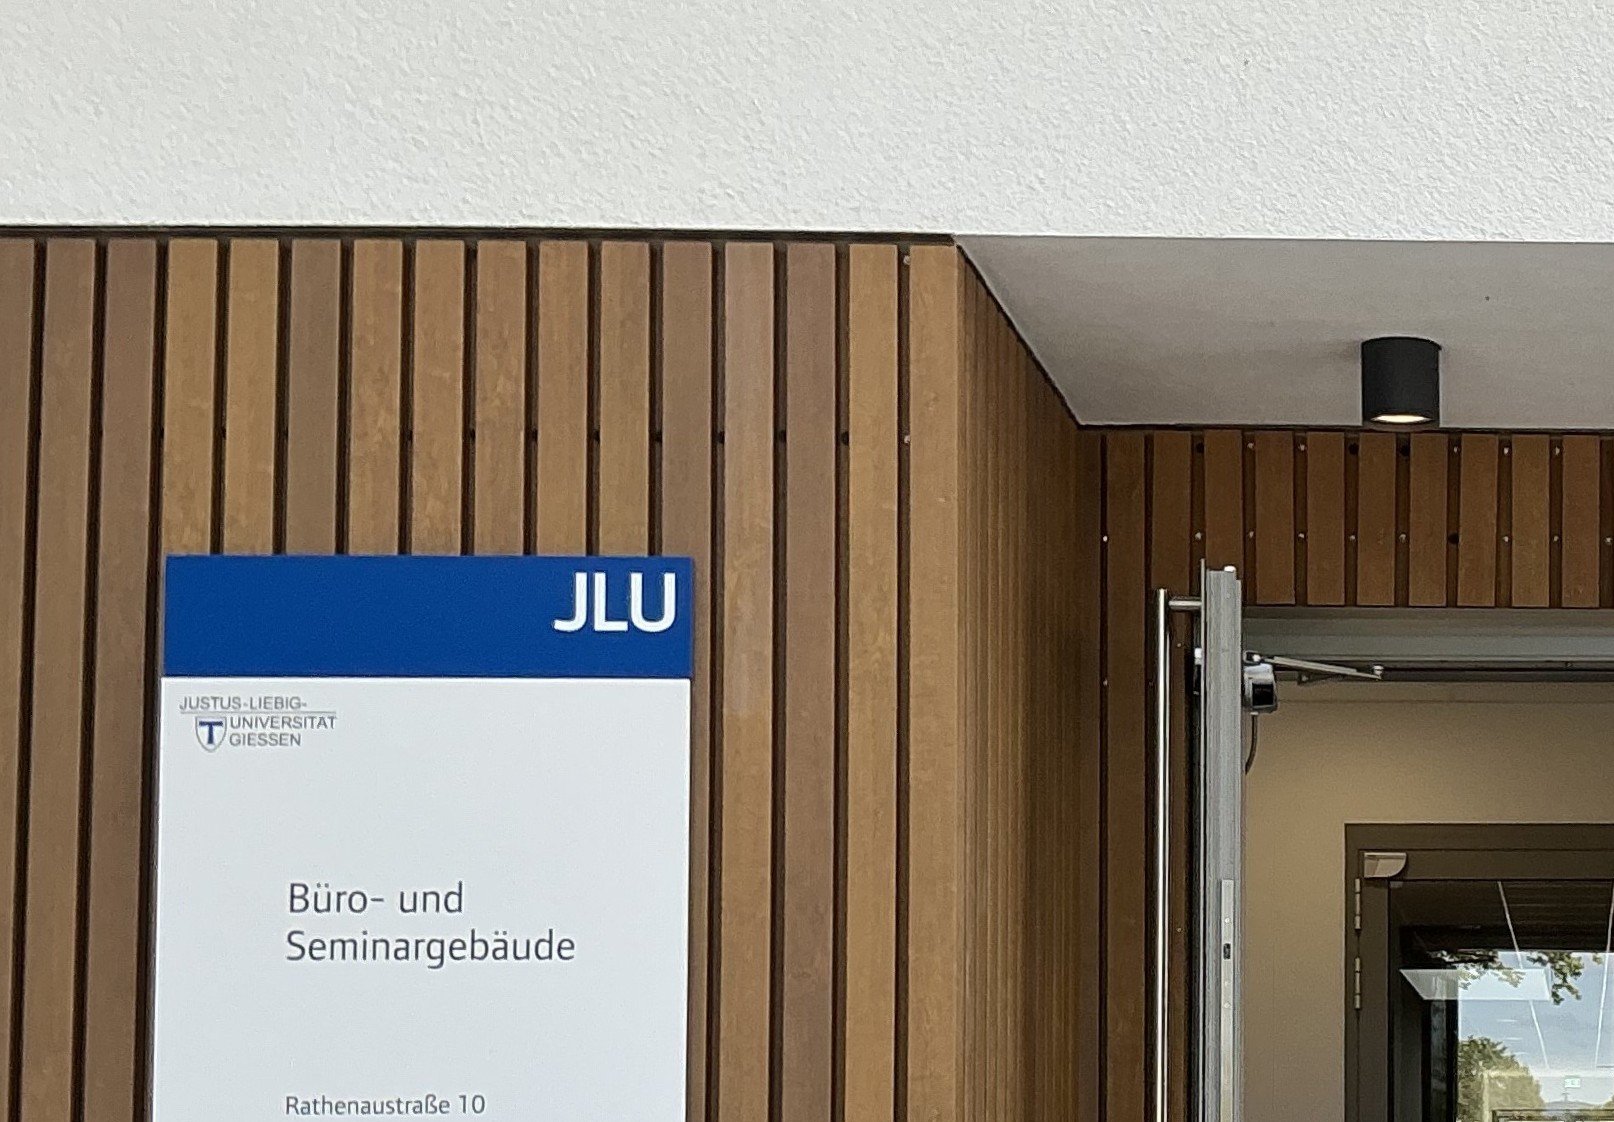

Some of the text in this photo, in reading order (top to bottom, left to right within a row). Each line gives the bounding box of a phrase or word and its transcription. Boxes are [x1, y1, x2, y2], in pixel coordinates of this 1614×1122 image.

[553, 571, 677, 633] JLU
[179, 696, 307, 711] JUSTUS-LIEBIG-
[229, 733, 302, 747] GIESSEN
[289, 881, 463, 914] Büro- und
[286, 928, 575, 969] Seminargebäude
[285, 1093, 486, 1116] Rathenaustraße 10
